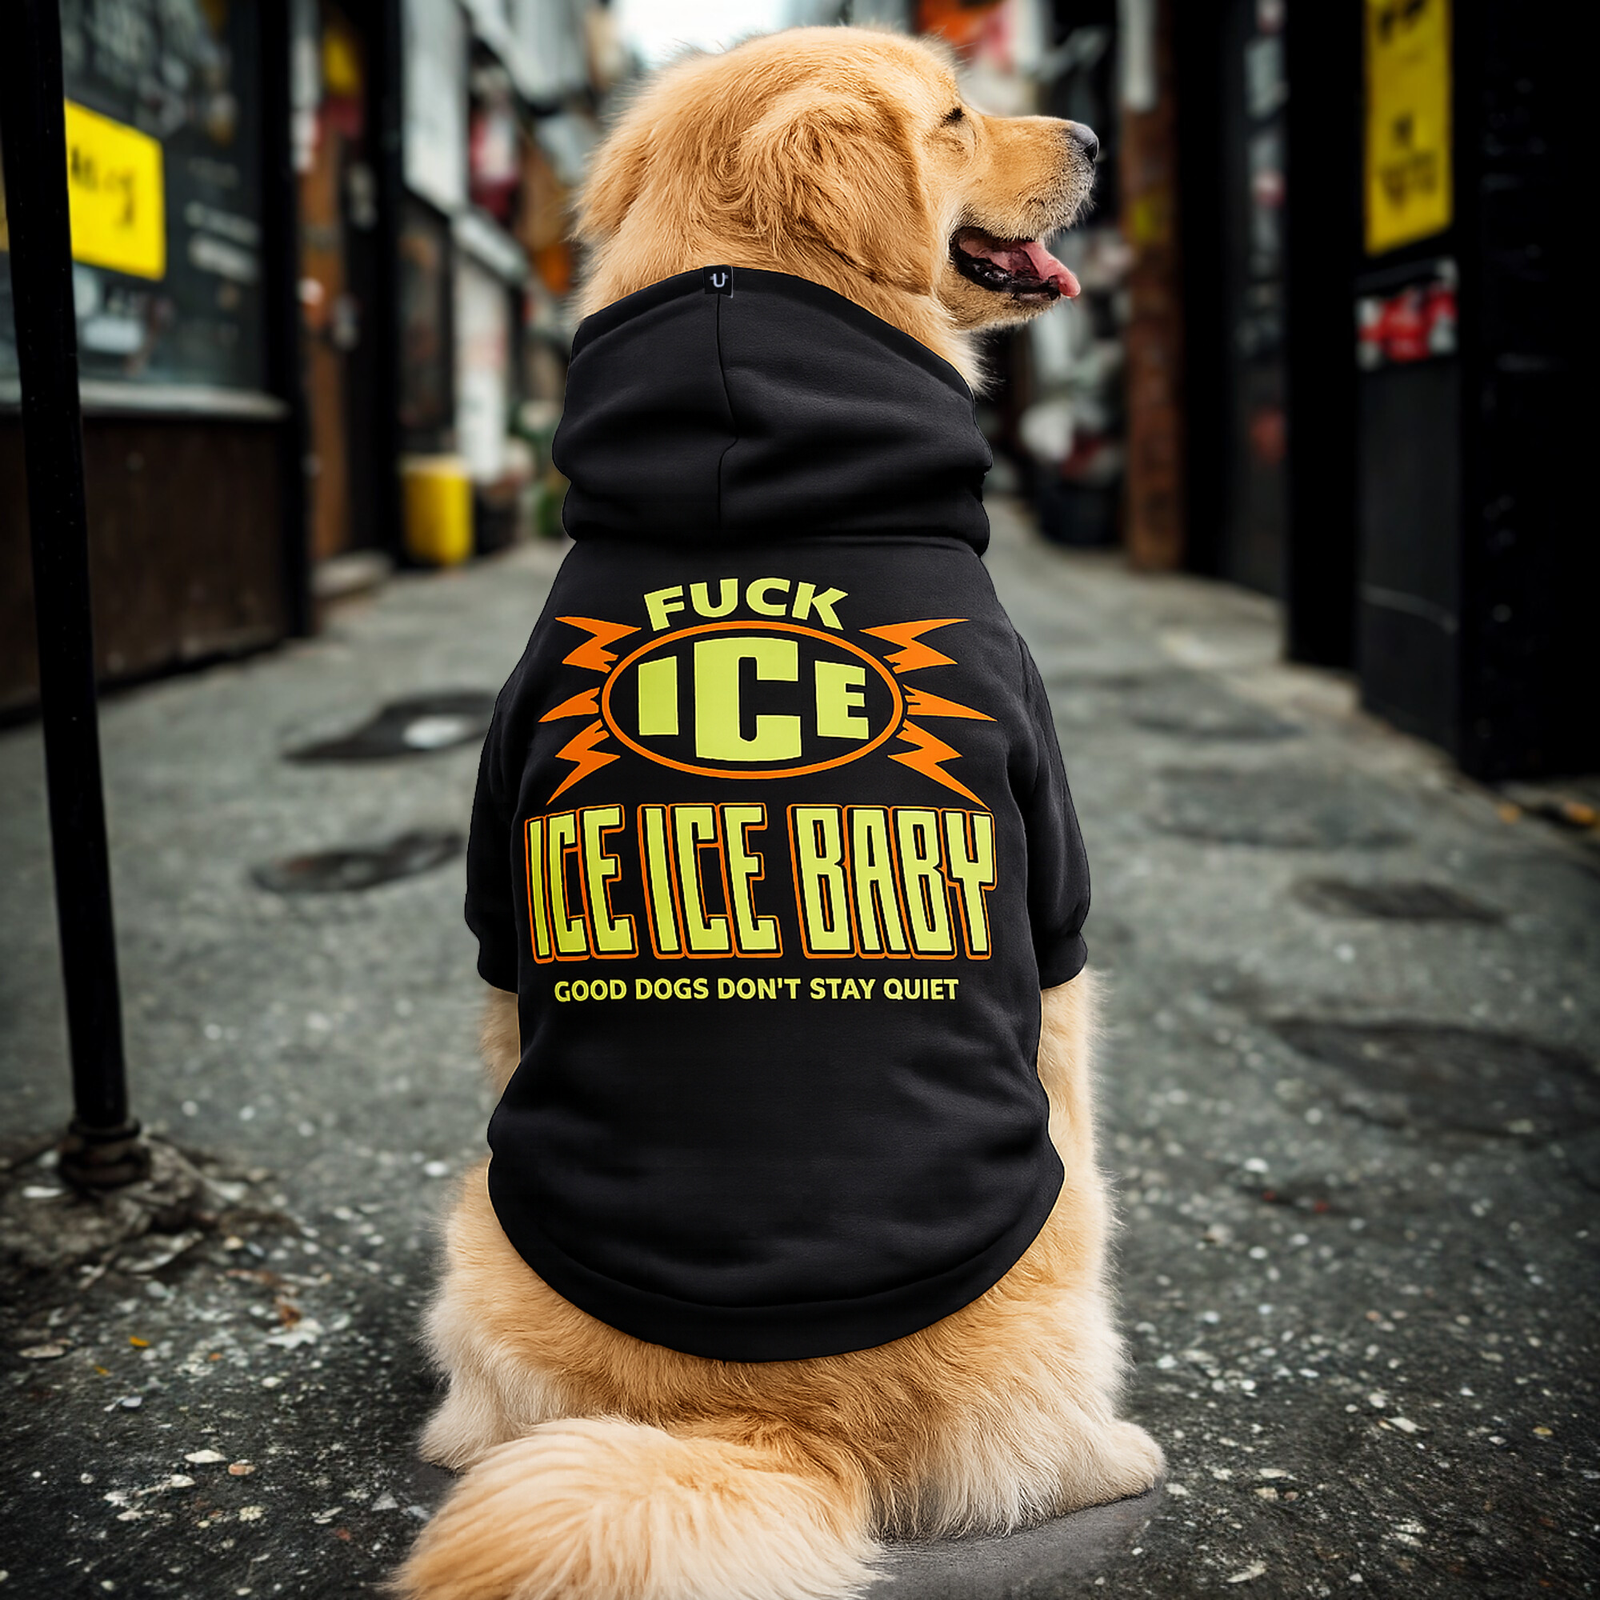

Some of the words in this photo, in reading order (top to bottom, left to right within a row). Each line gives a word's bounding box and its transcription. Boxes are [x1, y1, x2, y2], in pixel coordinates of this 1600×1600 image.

[643, 577, 849, 632] FUCK
[638, 636, 869, 762] ICE
[525, 804, 637, 963] ICE
[638, 803, 782, 959] ICE
[787, 804, 997, 961] BABY
[553, 979, 628, 1003] GOOD
[635, 977, 709, 1001] DOGS
[717, 977, 801, 1000] DON'T
[809, 977, 876, 1000] STAY
[883, 978, 960, 1001] QUIET
